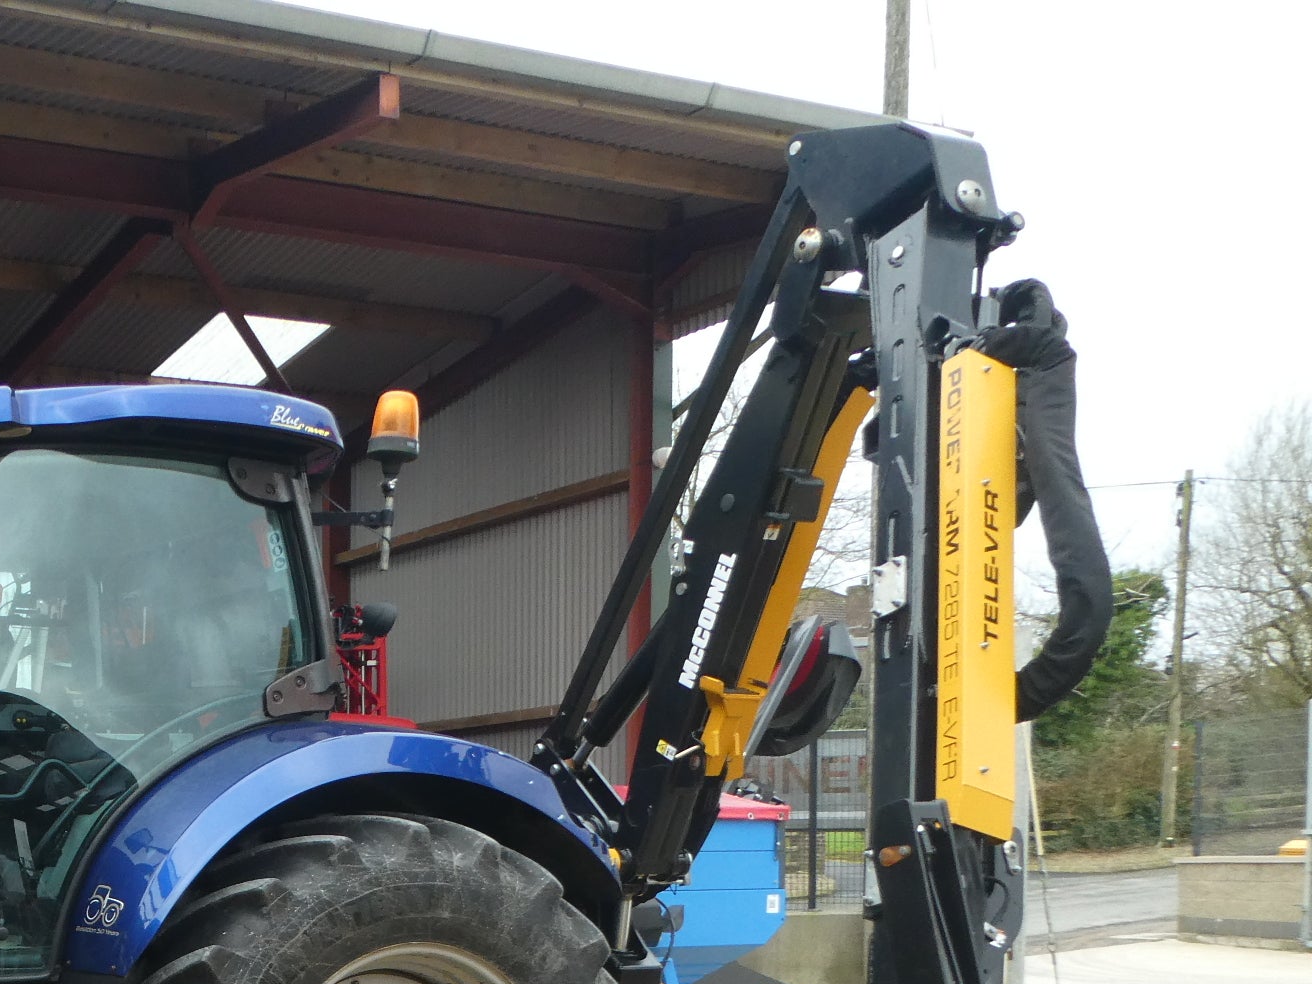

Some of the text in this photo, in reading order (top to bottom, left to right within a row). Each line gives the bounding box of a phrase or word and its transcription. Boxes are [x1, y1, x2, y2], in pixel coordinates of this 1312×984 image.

[271, 405, 300, 426] Blue
[678, 552, 737, 689] McCONNEL
[983, 489, 999, 643] TELE-VFR
